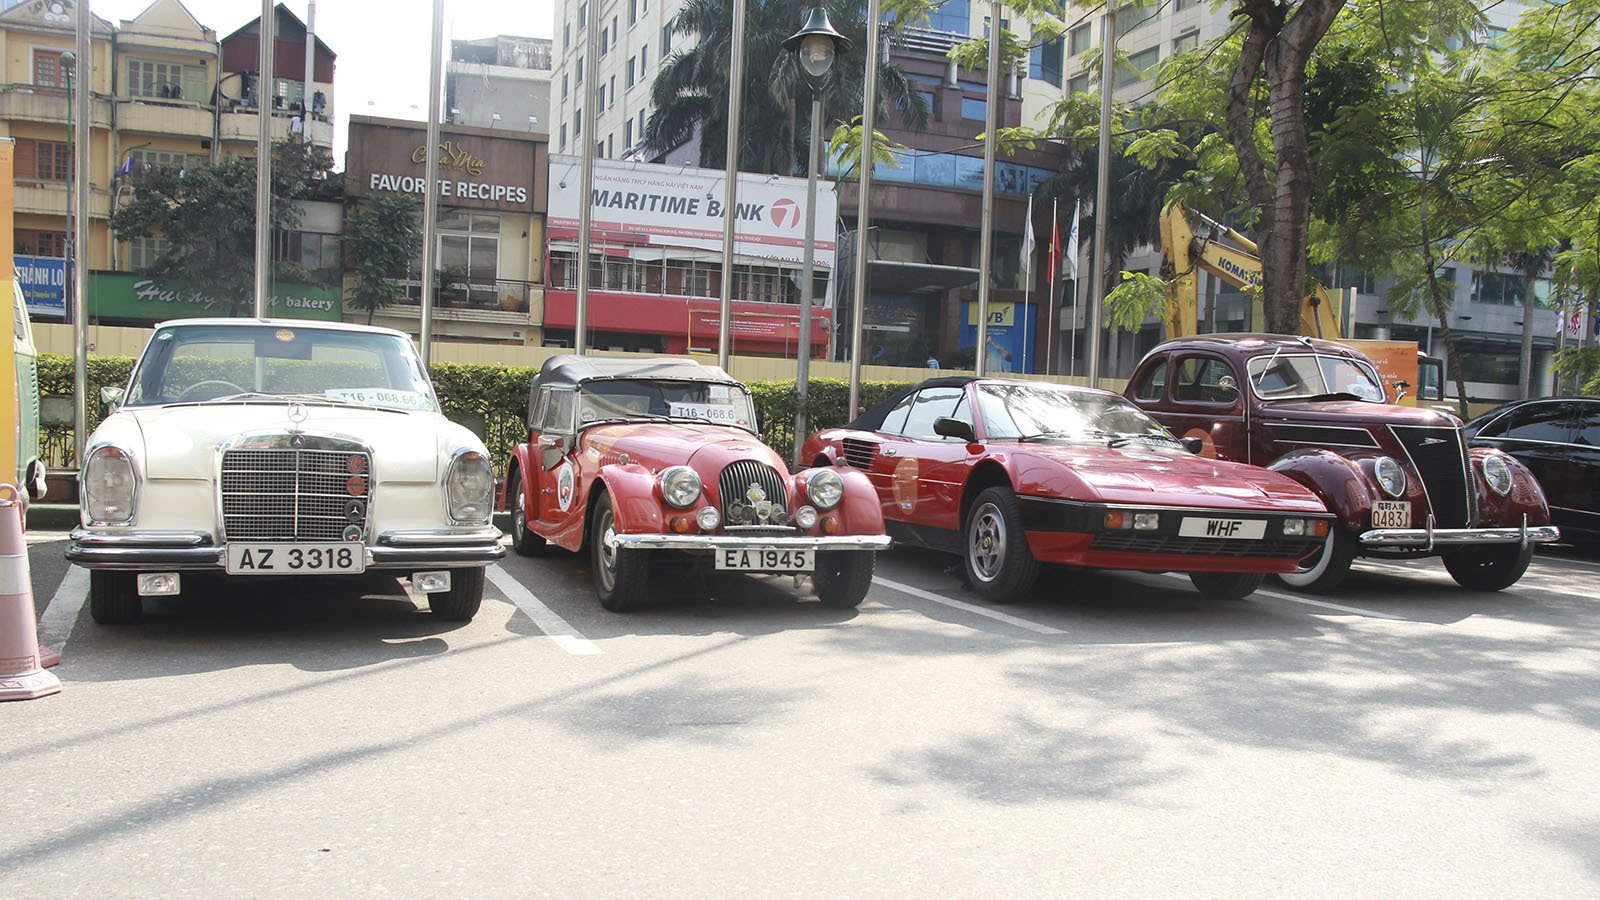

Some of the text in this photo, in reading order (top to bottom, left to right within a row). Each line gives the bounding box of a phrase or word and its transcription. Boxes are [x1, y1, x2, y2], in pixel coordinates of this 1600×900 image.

[370, 173, 527, 203] FAVORTE RECIPES
[590, 189, 700, 216] MARITIME
[286, 296, 334, 312] bakery
[678, 407, 698, 418] T16
[1206, 520, 1243, 537] WHF
[239, 547, 354, 570] AZ 3318
[725, 549, 806, 569] EA 1945
